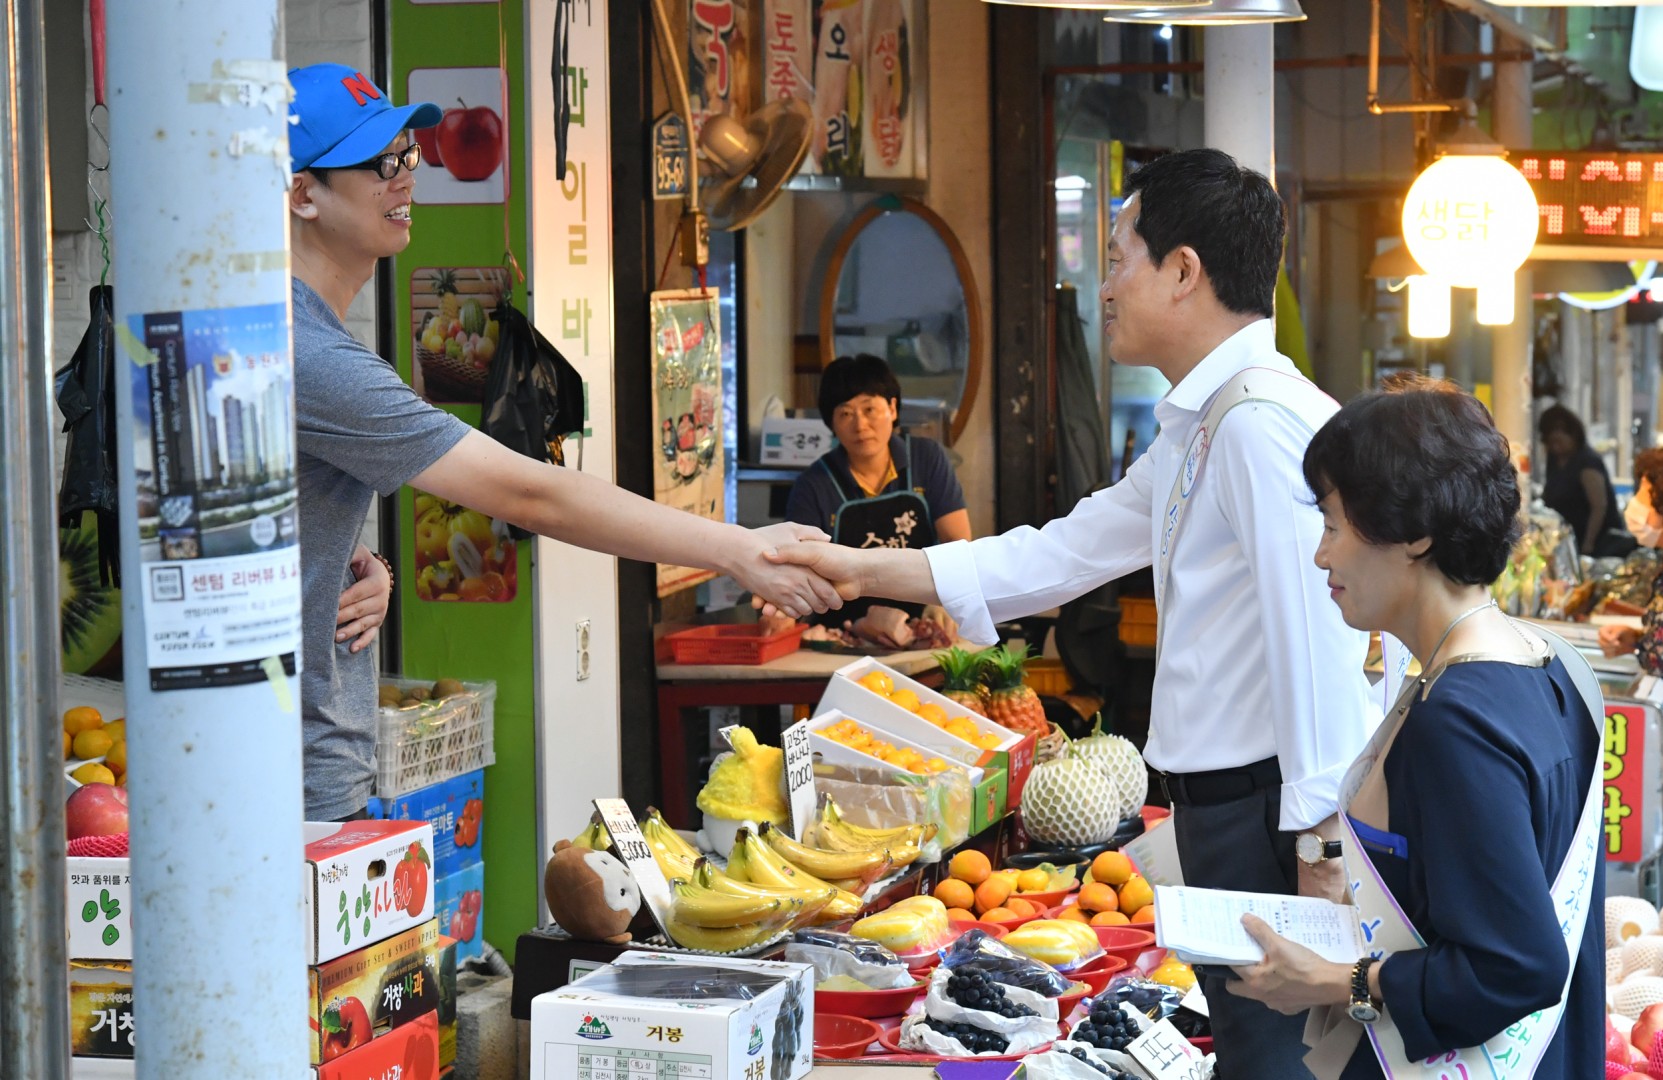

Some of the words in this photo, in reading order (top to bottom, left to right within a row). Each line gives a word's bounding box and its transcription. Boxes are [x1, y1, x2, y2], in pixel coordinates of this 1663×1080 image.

[1417, 196, 1496, 242] 생닭
[191, 573, 224, 593] 센텀
[232, 566, 274, 588] 리버뷰
[786, 725, 807, 750] 고당도
[788, 743, 810, 766] 바나나
[71, 874, 90, 885] 맛과
[93, 874, 121, 886] 품위를
[322, 965, 354, 985] PREMIUM
[357, 958, 371, 971] GIFT
[374, 953, 385, 965] SET
[395, 939, 415, 955] SWEET
[418, 928, 437, 944] APPLE
[645, 1025, 684, 1043] 거봉
[1139, 1032, 1184, 1072] 포도
